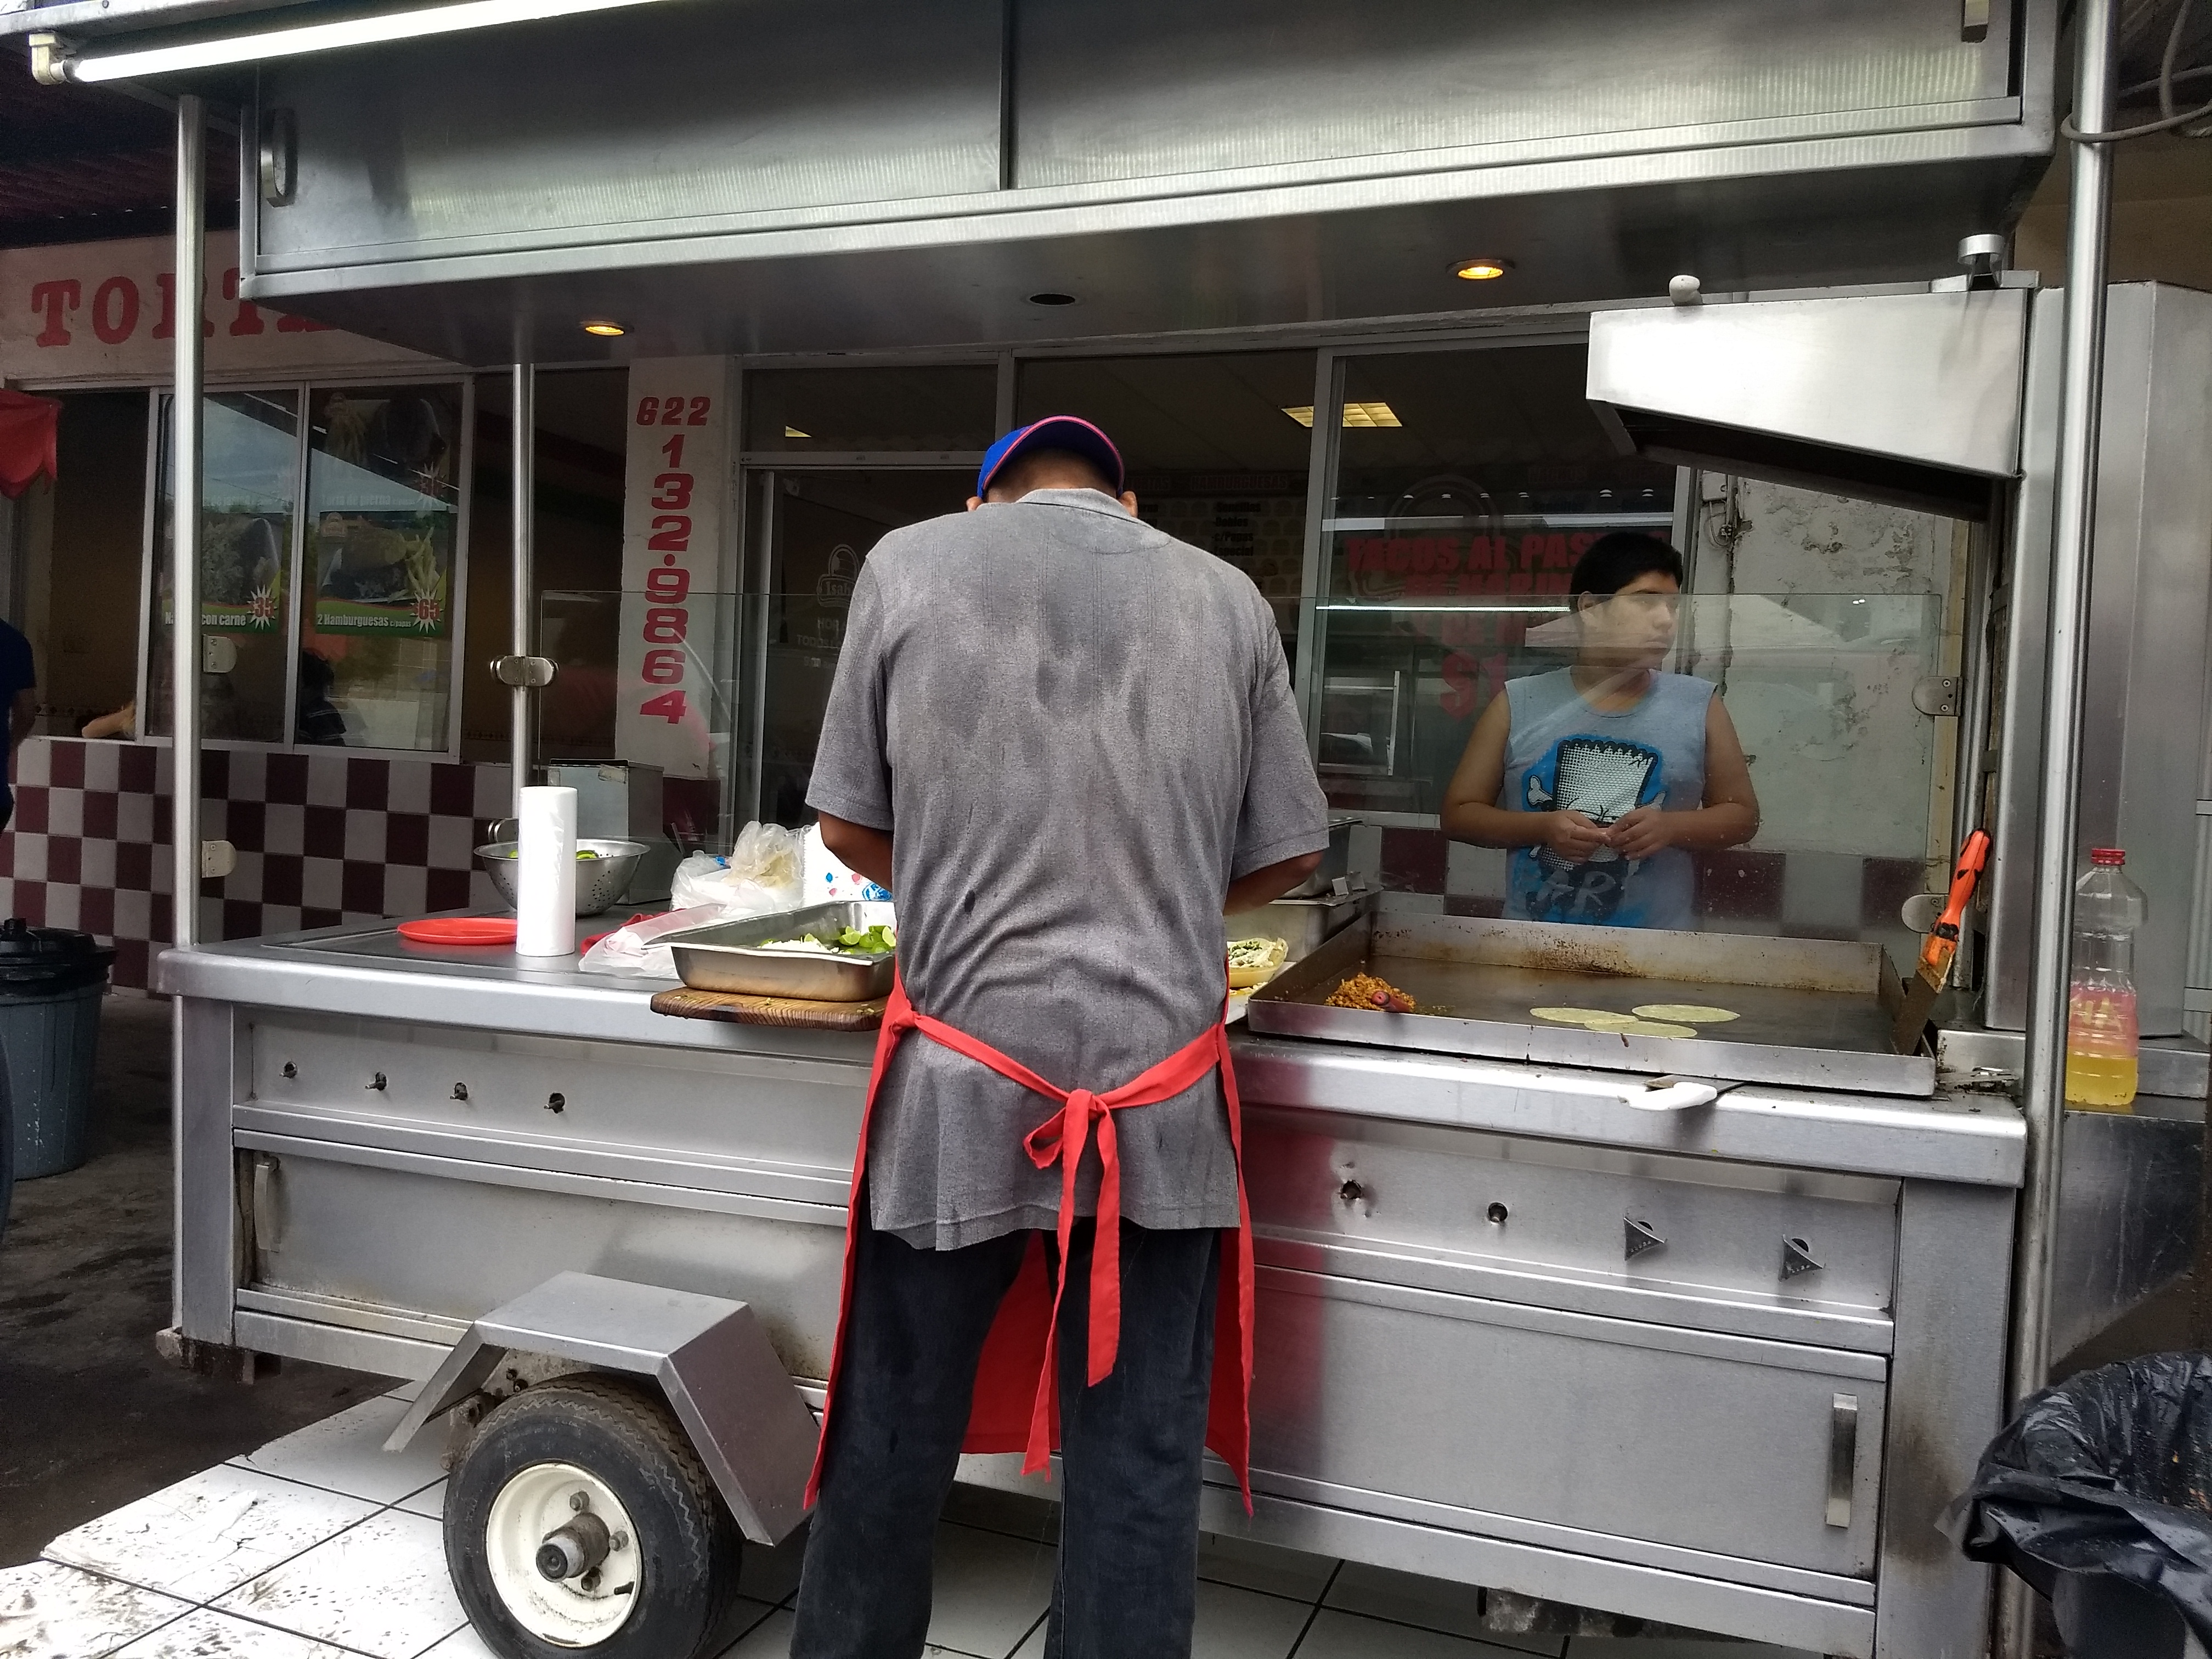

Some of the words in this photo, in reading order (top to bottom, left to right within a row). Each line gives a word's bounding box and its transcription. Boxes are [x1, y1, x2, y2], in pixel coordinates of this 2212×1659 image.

[636, 396, 711, 426] 622
[1190, 474, 1288, 492] HAMBURGUESAS
[1344, 537, 1461, 572] TACOS
[1469, 534, 1508, 569] AL
[219, 614, 246, 626] carne
[317, 614, 323, 625] 2
[324, 614, 389, 627] Hamburguesas
